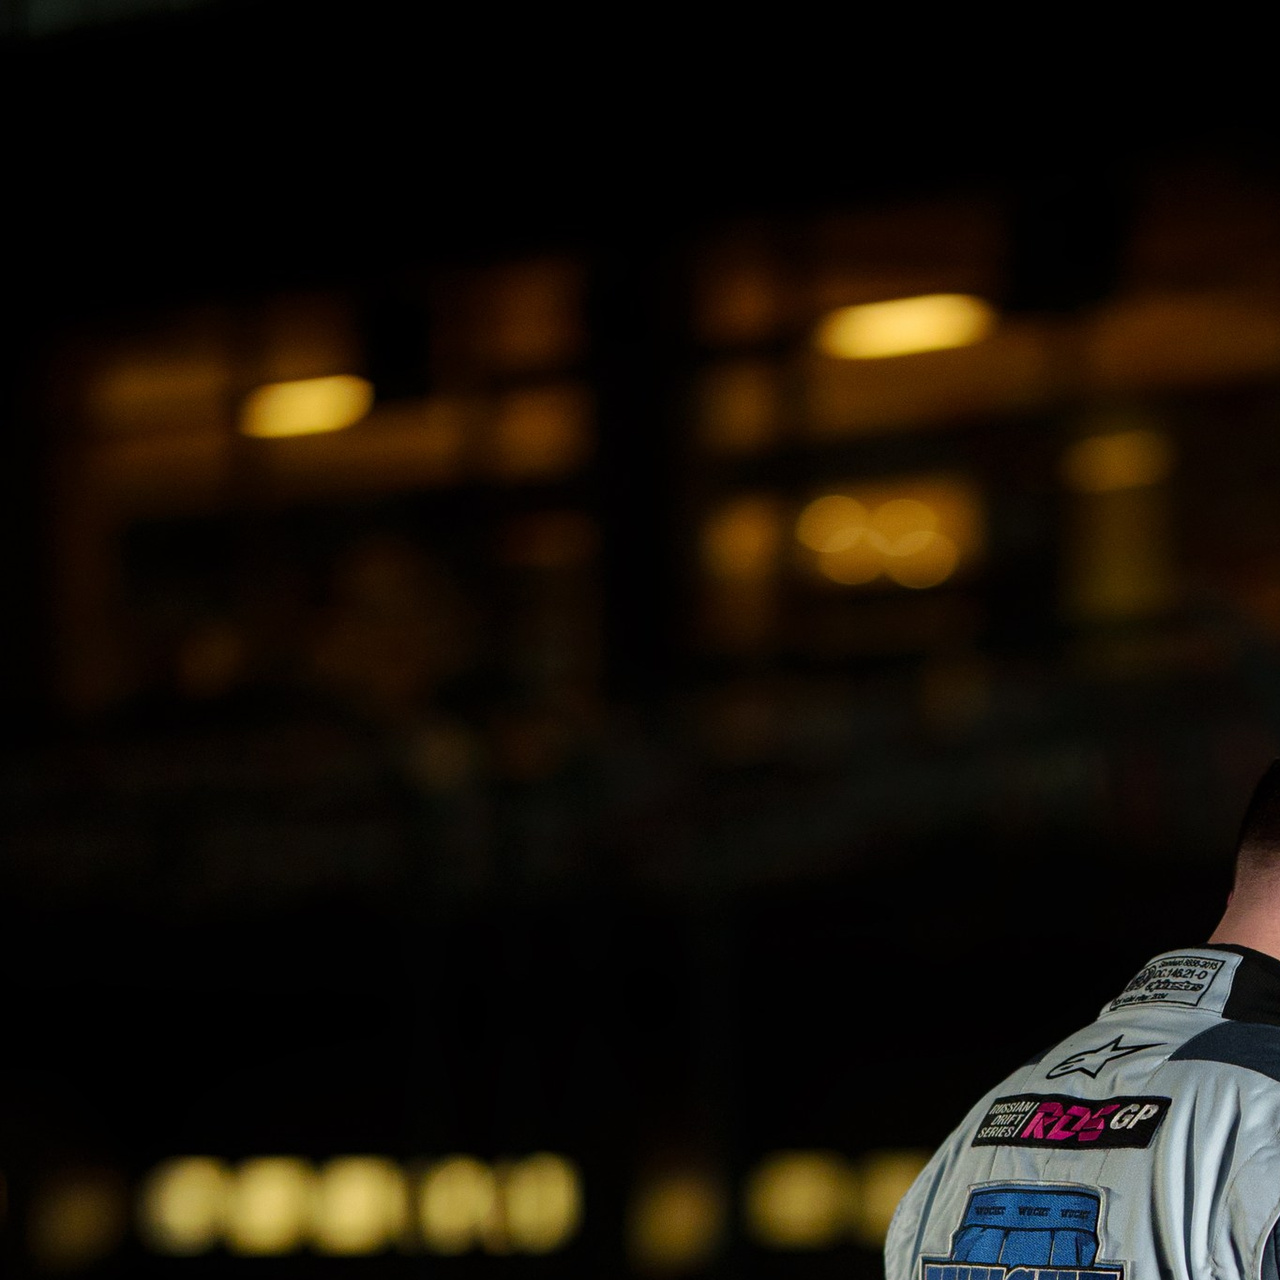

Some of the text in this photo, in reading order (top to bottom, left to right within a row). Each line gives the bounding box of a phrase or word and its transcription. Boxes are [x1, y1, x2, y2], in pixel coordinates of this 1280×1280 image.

[989, 1100, 1031, 1116] RUSSIAN
[991, 1113, 1025, 1126] DRIFT
[1110, 1103, 1160, 1130] GP
[978, 1126, 1015, 1138] SERIES
